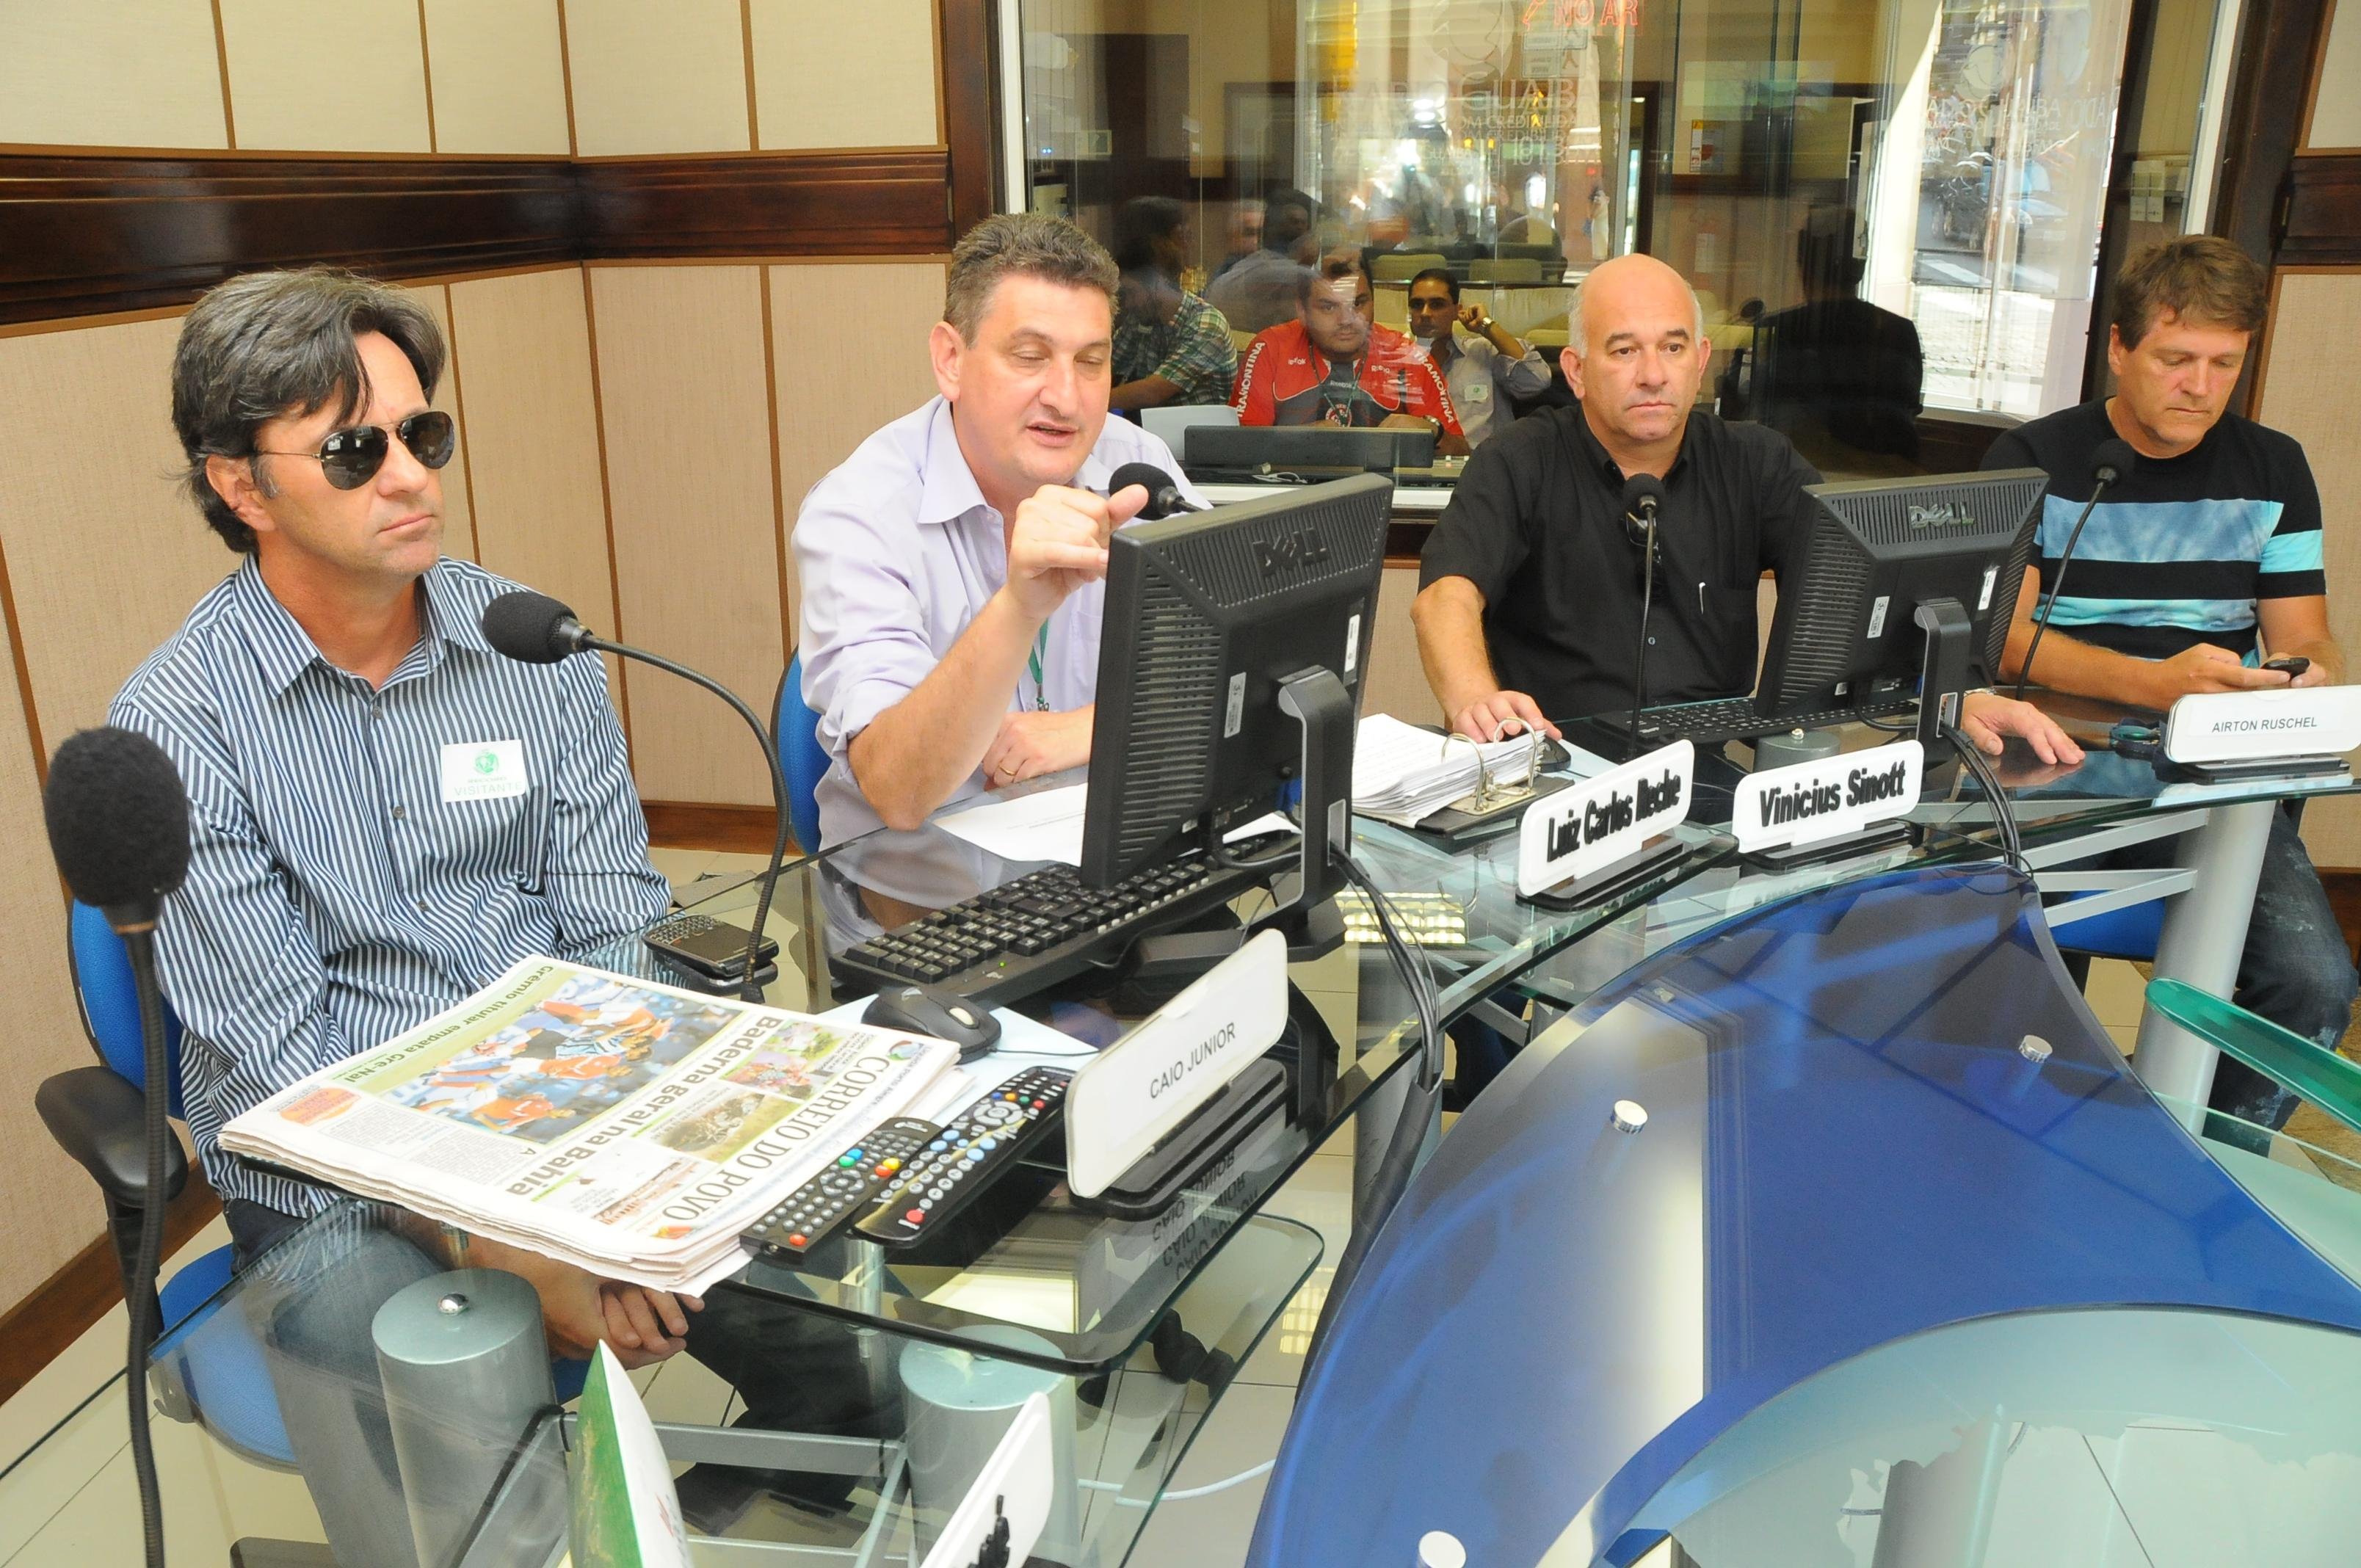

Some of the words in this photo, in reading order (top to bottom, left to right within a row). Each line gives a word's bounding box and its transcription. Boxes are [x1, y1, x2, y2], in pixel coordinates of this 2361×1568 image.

[1553, 0, 1595, 27] NO
[1600, 0, 1639, 26] AR
[1909, 501, 1976, 530] DELL
[1252, 527, 1328, 576] DELL
[2211, 719, 2257, 733] AIRTON
[2260, 716, 2318, 730] RUSCHEL
[454, 781, 522, 796] VISITANTE
[1760, 777, 1840, 827] Vinicius
[1846, 761, 1906, 807] Sinott
[1546, 810, 1581, 863] Luiz
[1584, 790, 1633, 846] Carlos
[504, 965, 554, 1000] Grêmio
[462, 1000, 510, 1025] titular
[404, 1023, 463, 1055] empata
[683, 1015, 783, 1085] Baderna
[344, 1052, 407, 1084] Gre-Nal
[1149, 1061, 1184, 1100] CAIO
[1187, 1022, 1236, 1072] JUNIOR
[620, 1084, 685, 1128] geral
[775, 1055, 890, 1141] CORREIO
[585, 1125, 628, 1147] na
[507, 1146, 597, 1197] Bahia
[736, 1139, 791, 1169] DO
[662, 1169, 752, 1224] POVO
